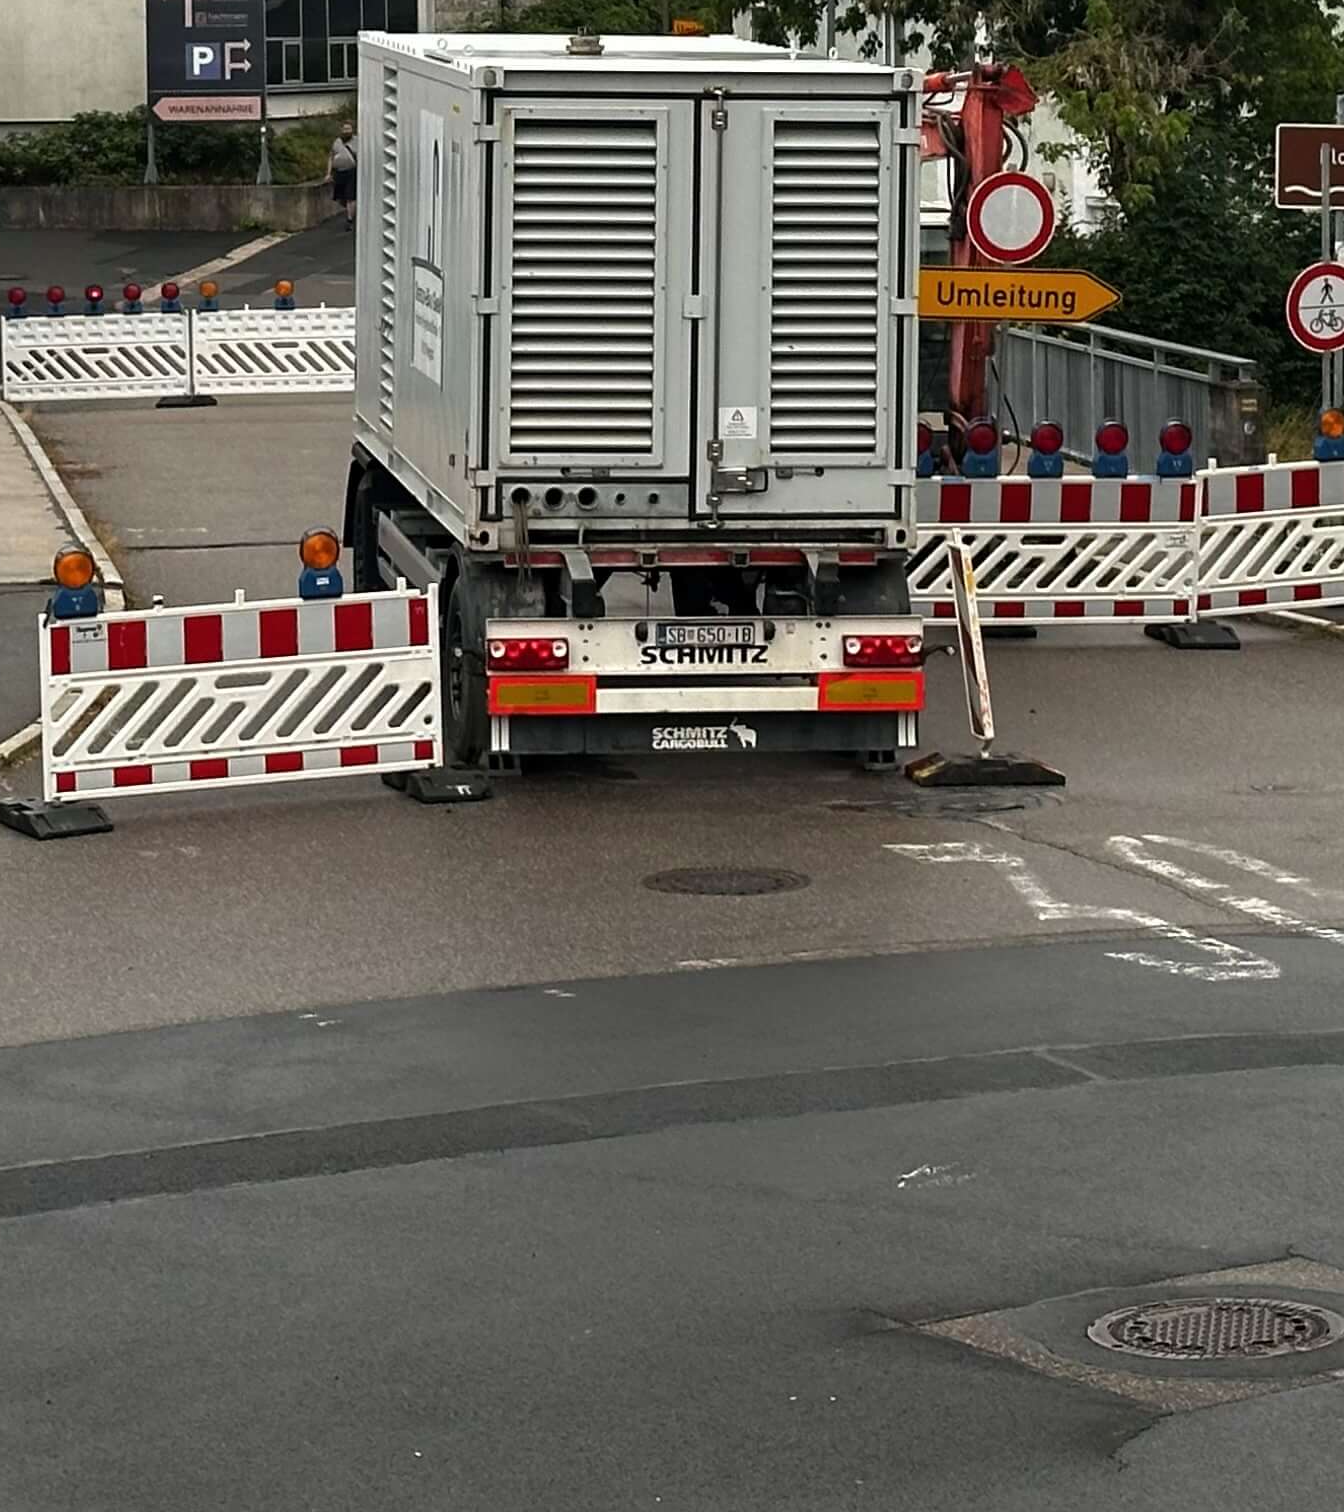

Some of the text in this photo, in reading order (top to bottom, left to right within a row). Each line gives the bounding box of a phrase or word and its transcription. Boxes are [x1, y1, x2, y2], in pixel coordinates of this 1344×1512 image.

[192, 46, 214, 76] P
[167, 104, 254, 115] WARENANNAHME
[937, 280, 1077, 314] Umleitung
[641, 645, 768, 664] SCHMITZ
[652, 726, 728, 739] SCHMITZ
[652, 738, 728, 749] CARGOBULL
